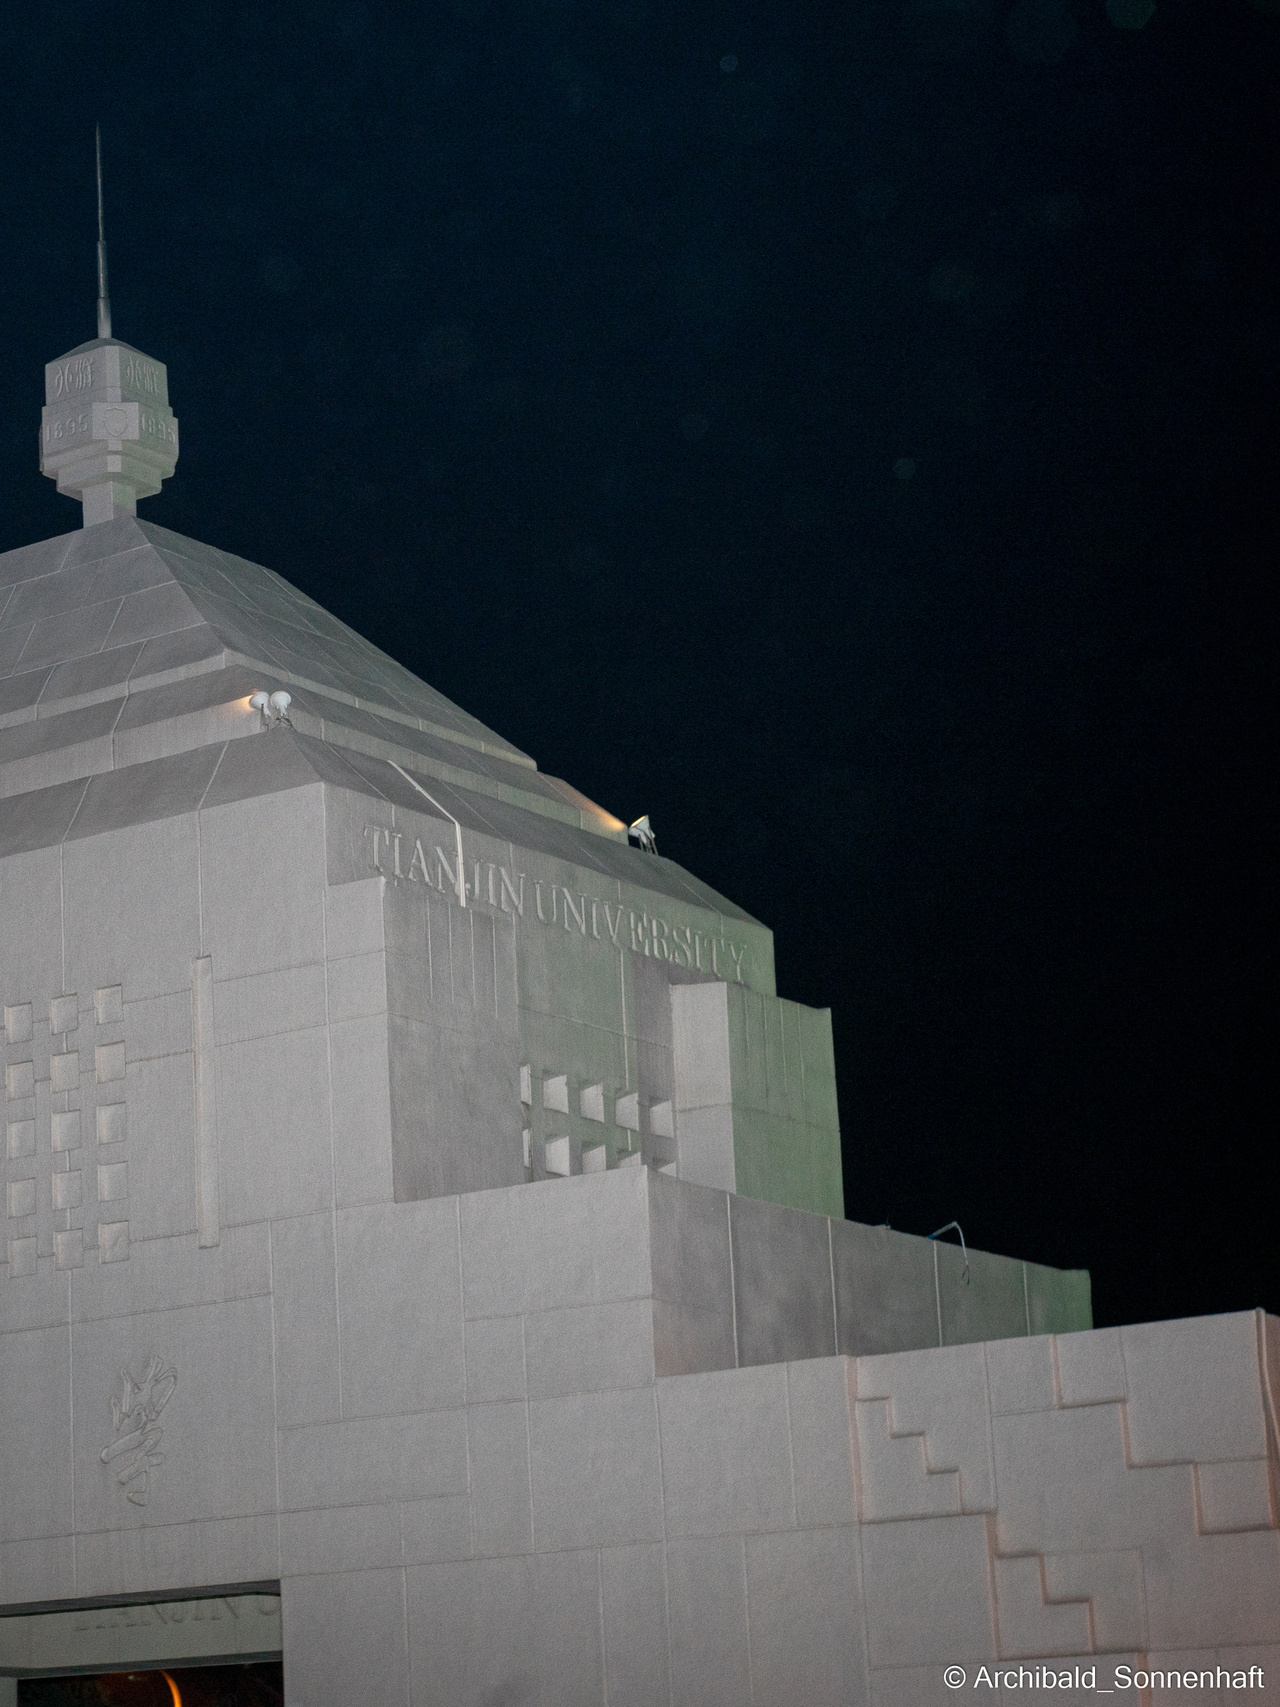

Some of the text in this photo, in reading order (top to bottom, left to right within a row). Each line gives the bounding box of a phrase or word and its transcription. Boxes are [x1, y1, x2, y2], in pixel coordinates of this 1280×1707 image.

[45, 413, 89, 442] 1895
[141, 413, 176, 444] 1895
[363, 822, 749, 985] TIANJIN UNIVERSITY
